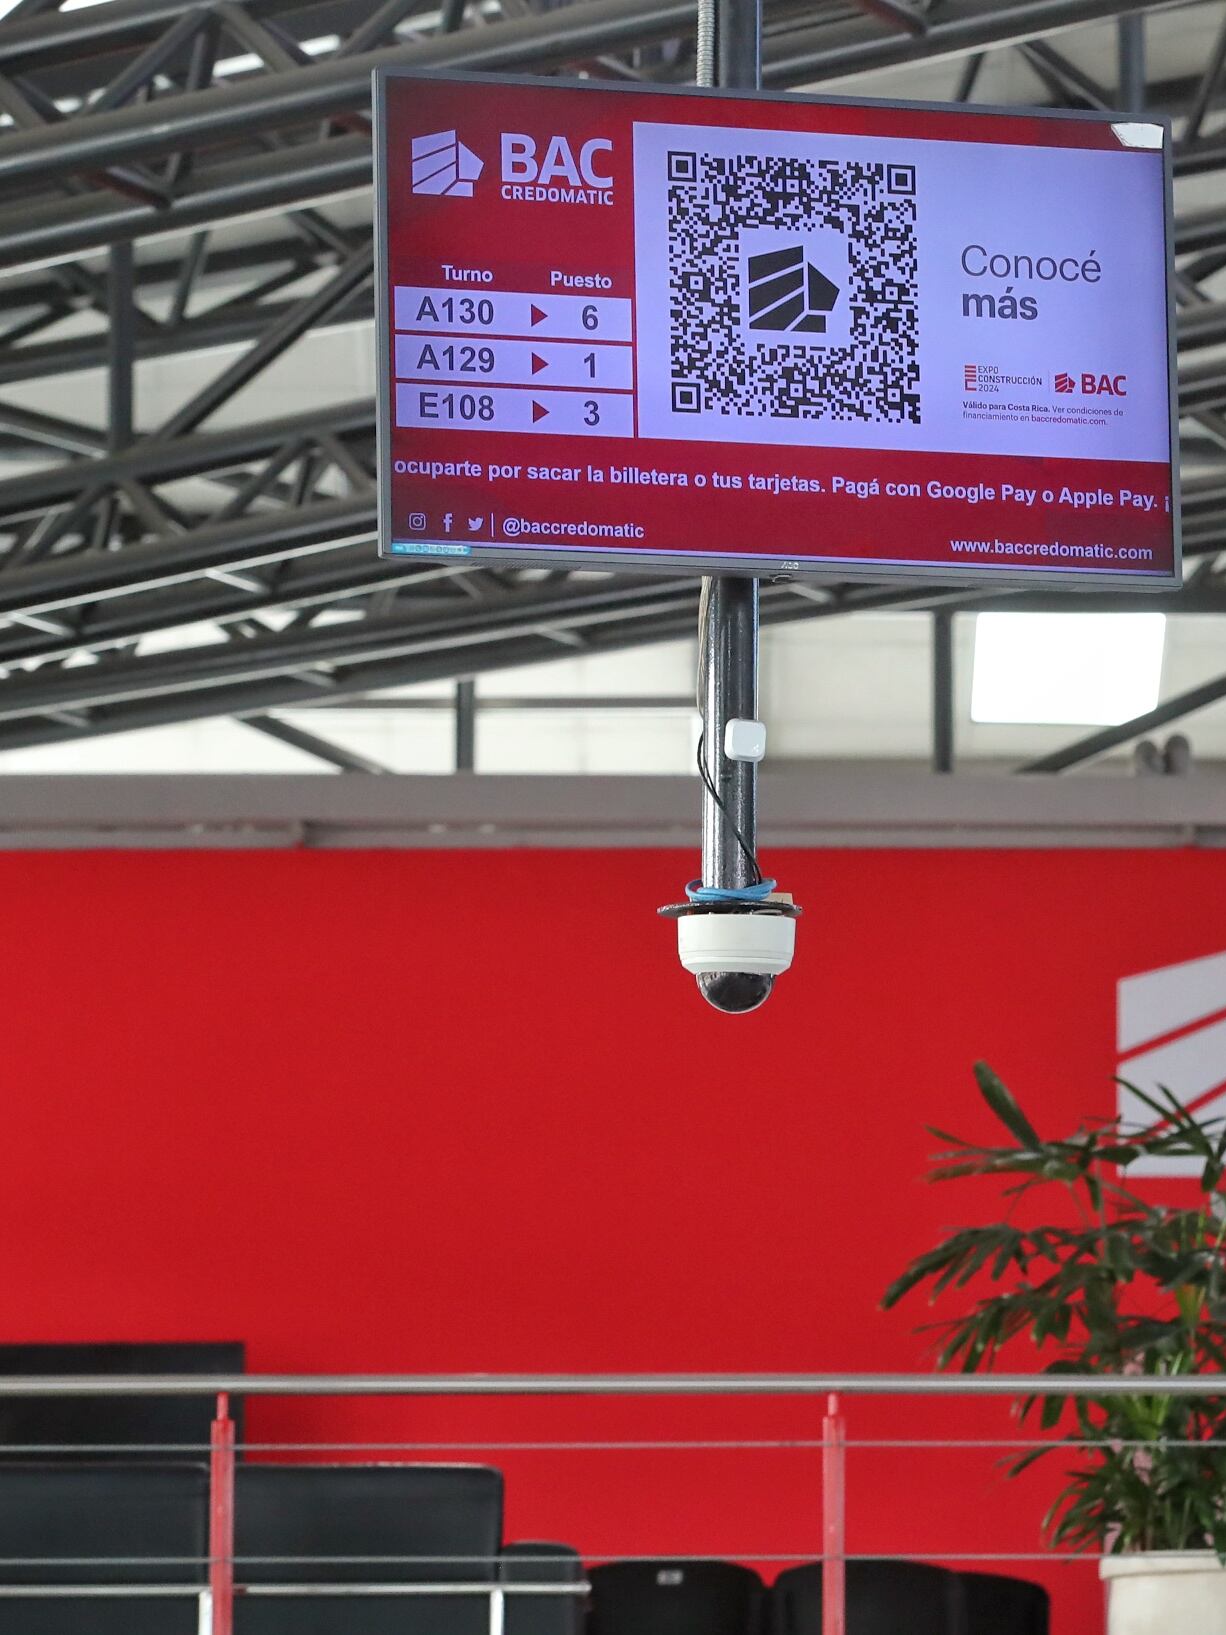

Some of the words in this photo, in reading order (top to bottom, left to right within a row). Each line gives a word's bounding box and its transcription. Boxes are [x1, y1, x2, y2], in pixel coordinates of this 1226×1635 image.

[500, 132, 614, 188] BAC
[501, 184, 615, 206] CREDOMATIC
[961, 244, 1102, 283] Conocé
[441, 264, 494, 283] Turno
[550, 270, 613, 289] Puesto
[415, 295, 494, 326] A130
[581, 304, 599, 330] 6
[962, 286, 1039, 320] más
[416, 344, 496, 373] A129
[583, 352, 597, 379] 1
[978, 365, 999, 374] EXPO
[978, 374, 1042, 386] CONSTRUCCIÓN
[978, 384, 1000, 393] 2024
[1081, 373, 1127, 396] BAC
[419, 392, 495, 421] E108
[583, 400, 601, 426] 3
[962, 401, 988, 409] Válido
[1007, 403, 1031, 412] Costa
[1032, 404, 1050, 413] Rica.
[1066, 406, 1112, 415] condiciones
[1114, 408, 1124, 416] de
[962, 411, 1019, 422] financiamiento
[1020, 414, 1030, 422] en
[394, 459, 482, 478] ocuparte
[489, 463, 521, 481] por
[527, 466, 581, 481] sacar
[587, 466, 604, 483] la
[610, 467, 688, 486] billetera
[694, 474, 707, 486] o
[712, 472, 742, 489] tus
[748, 474, 826, 495] tarjetas.
[832, 476, 880, 499] Pagá
[885, 481, 921, 497] con
[927, 480, 995, 504] Google
[1001, 485, 1036, 506] Pay
[1042, 489, 1054, 503] o
[1059, 488, 1114, 510] Apple
[1120, 490, 1158, 511] Pay.
[502, 518, 645, 539] @baccredomatic
[950, 539, 1153, 560] www.baccredomatic.com
